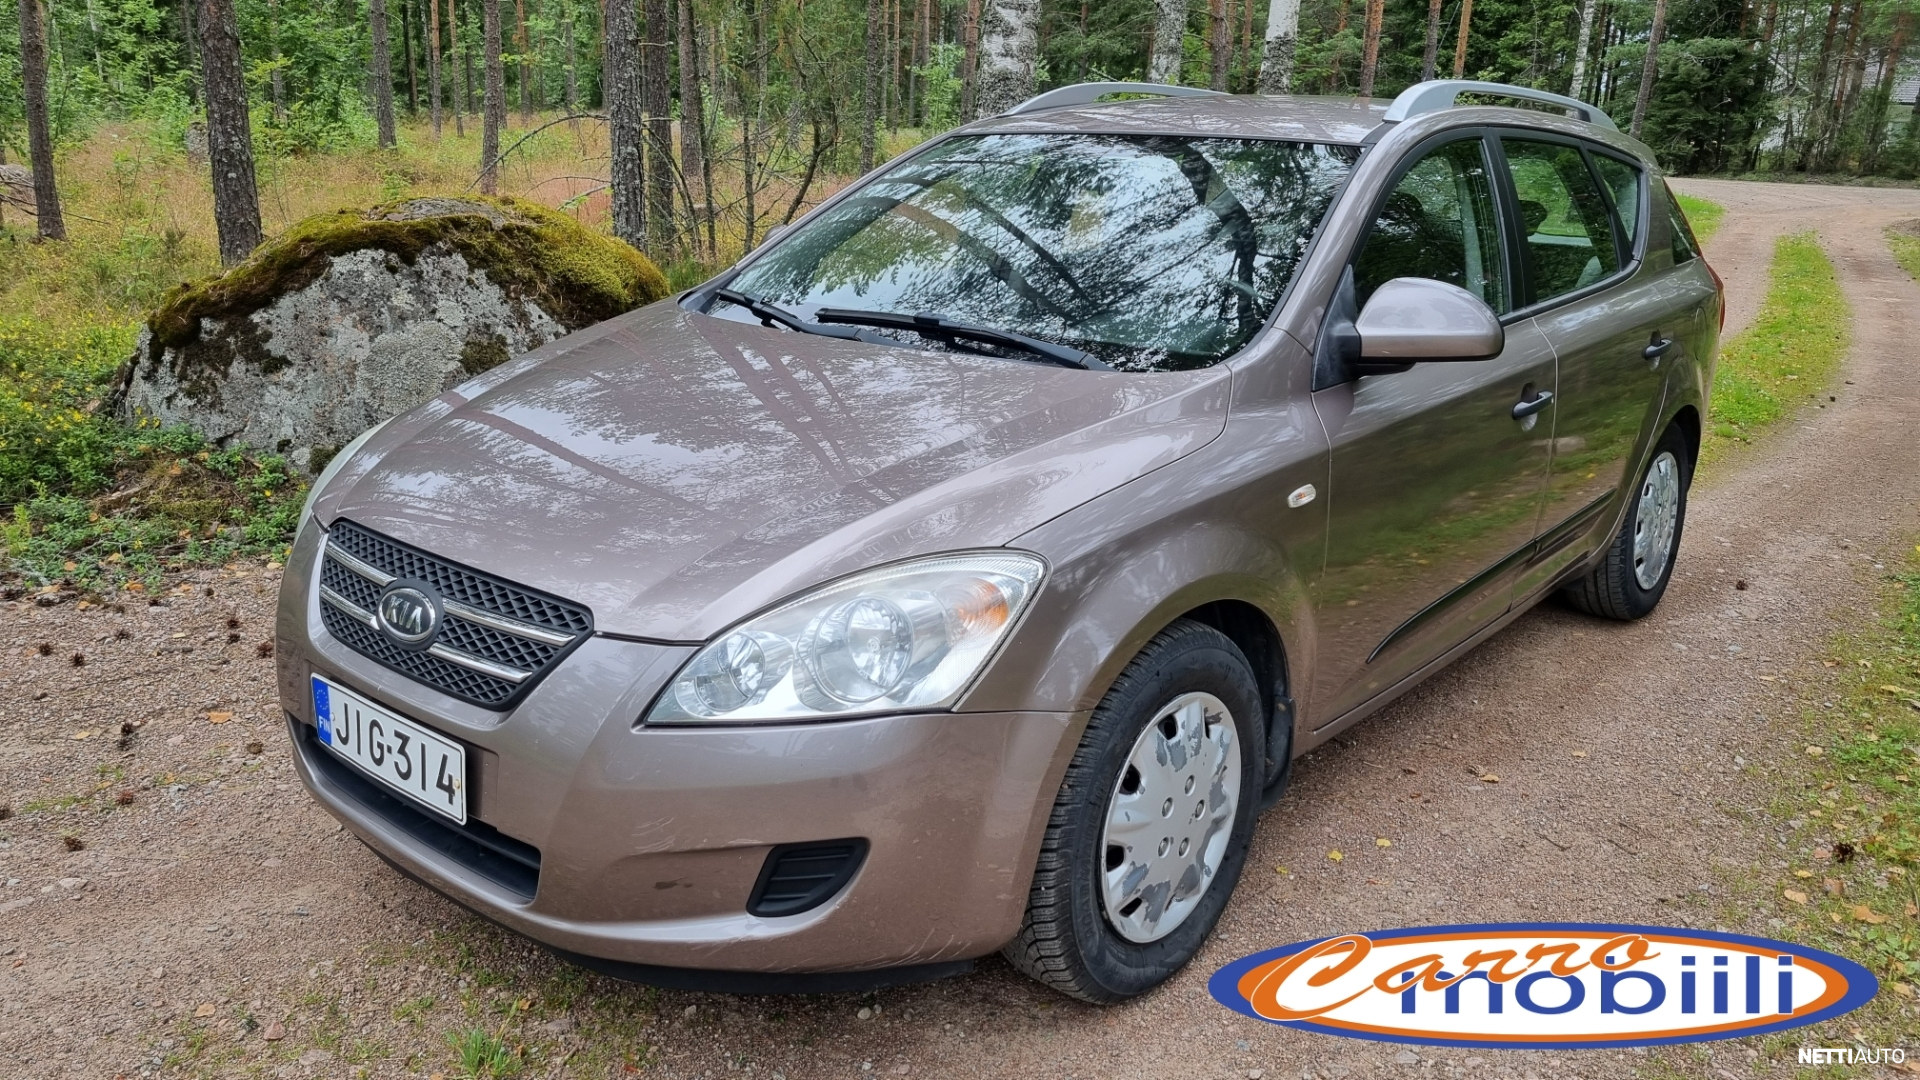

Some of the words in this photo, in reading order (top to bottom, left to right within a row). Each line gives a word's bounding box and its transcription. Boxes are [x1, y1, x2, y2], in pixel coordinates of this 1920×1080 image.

[385, 596, 422, 634] KIA
[318, 715, 331, 734] FIN
[336, 703, 455, 805] JIG-314
